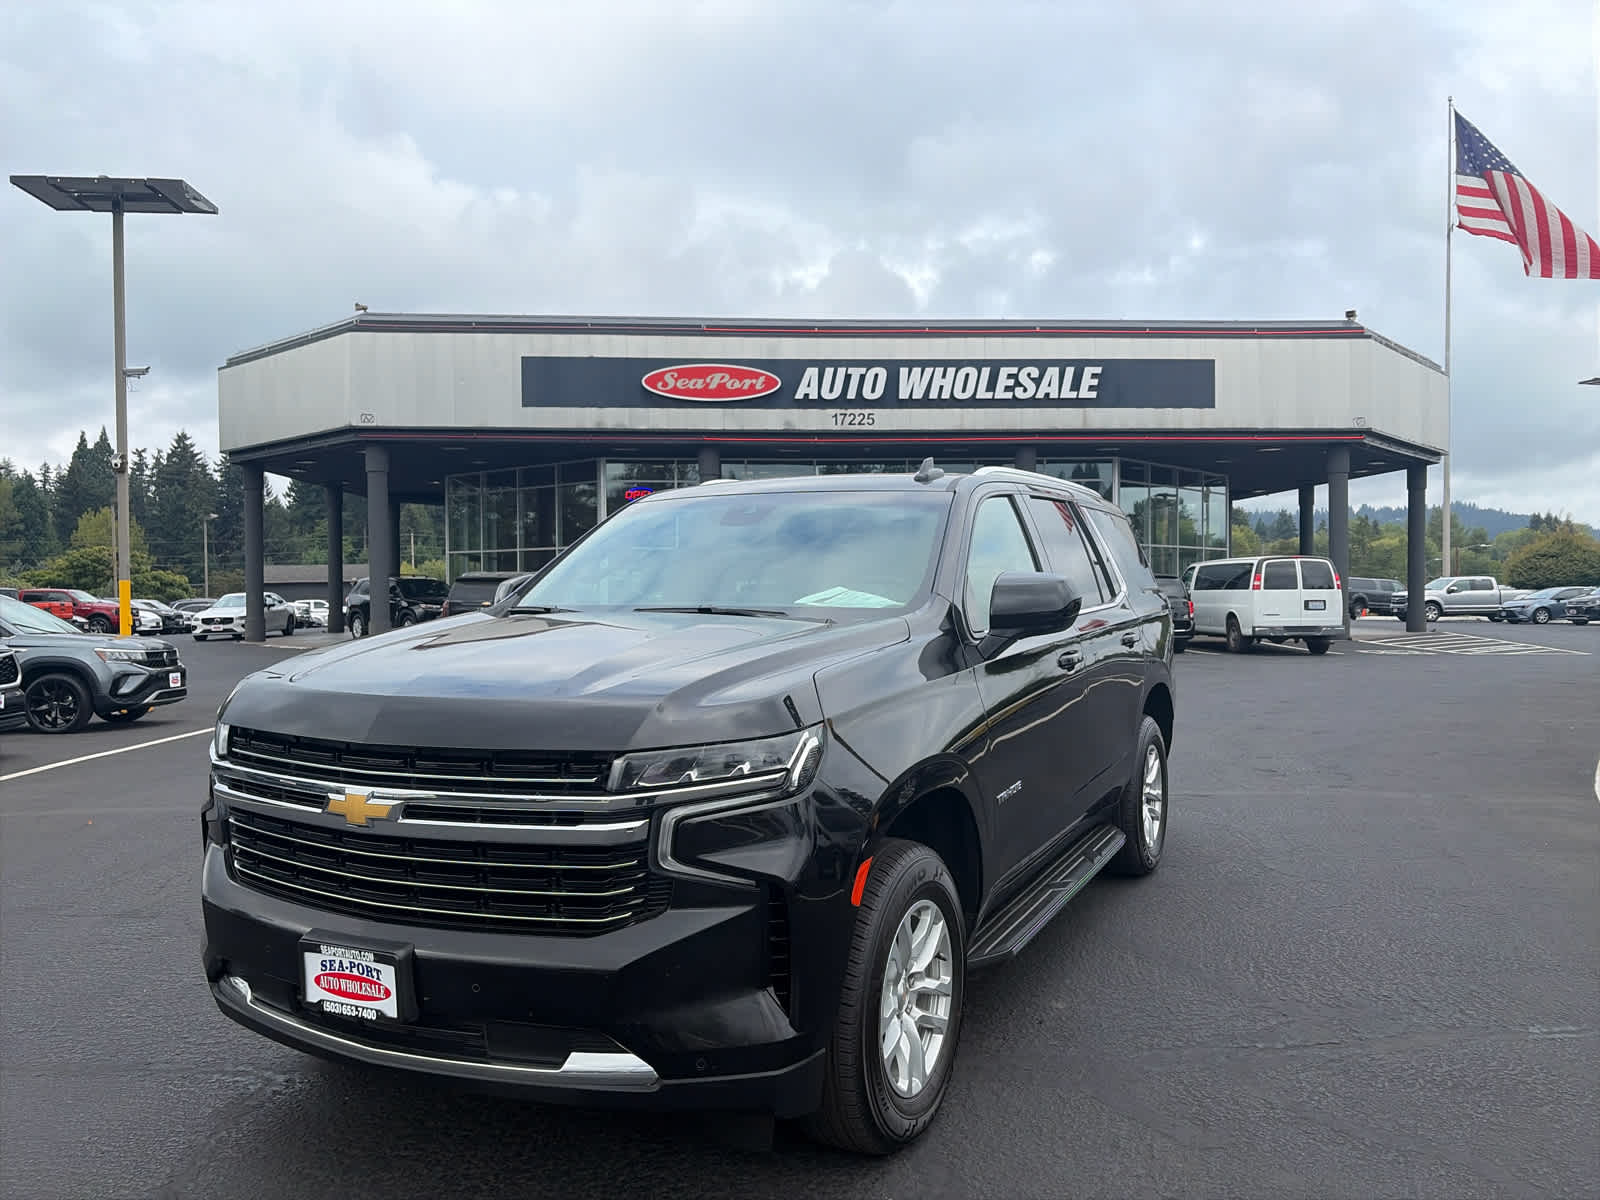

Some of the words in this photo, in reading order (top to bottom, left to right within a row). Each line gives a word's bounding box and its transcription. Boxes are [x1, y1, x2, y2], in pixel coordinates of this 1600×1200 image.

[794, 366, 888, 400] AUTO
[898, 366, 1103, 400] WHOLESALE
[831, 412, 876, 426] 17225
[320, 975, 339, 990] AUTO
[340, 978, 386, 999] WHOLESALE
